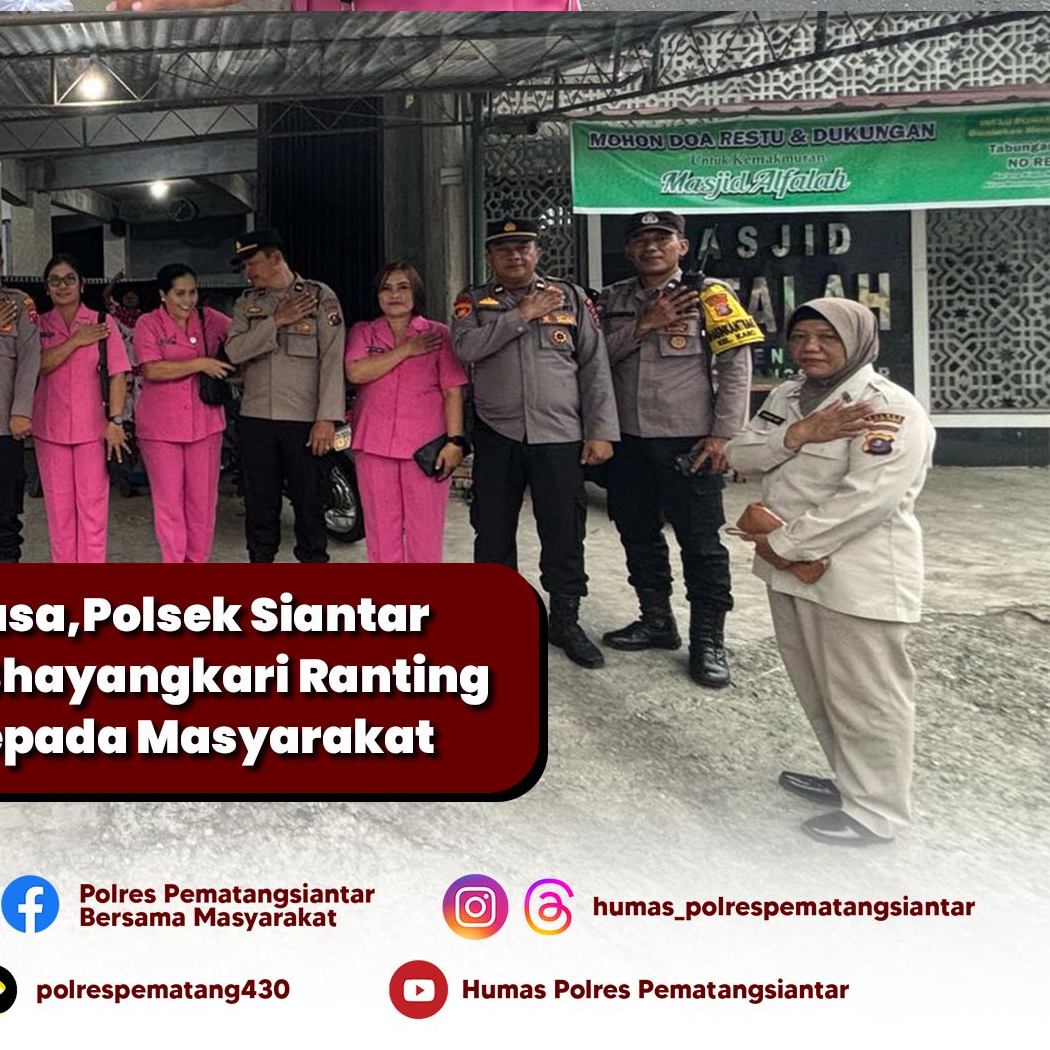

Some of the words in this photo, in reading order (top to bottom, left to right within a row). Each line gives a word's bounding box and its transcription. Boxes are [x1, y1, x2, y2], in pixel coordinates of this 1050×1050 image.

[589, 132, 665, 148] MOHON
[669, 130, 713, 147] DOA
[719, 128, 785, 147] RESTU
[790, 127, 807, 144] &
[813, 123, 935, 144] DUKUNGAN
[692, 153, 729, 166] Untuk
[733, 152, 827, 166] Kemakmuran
[1008, 158, 1029, 168] NO
[661, 169, 751, 199] Masjid
[752, 167, 851, 198] Alfalah
[698, 222, 852, 259] ASJID
